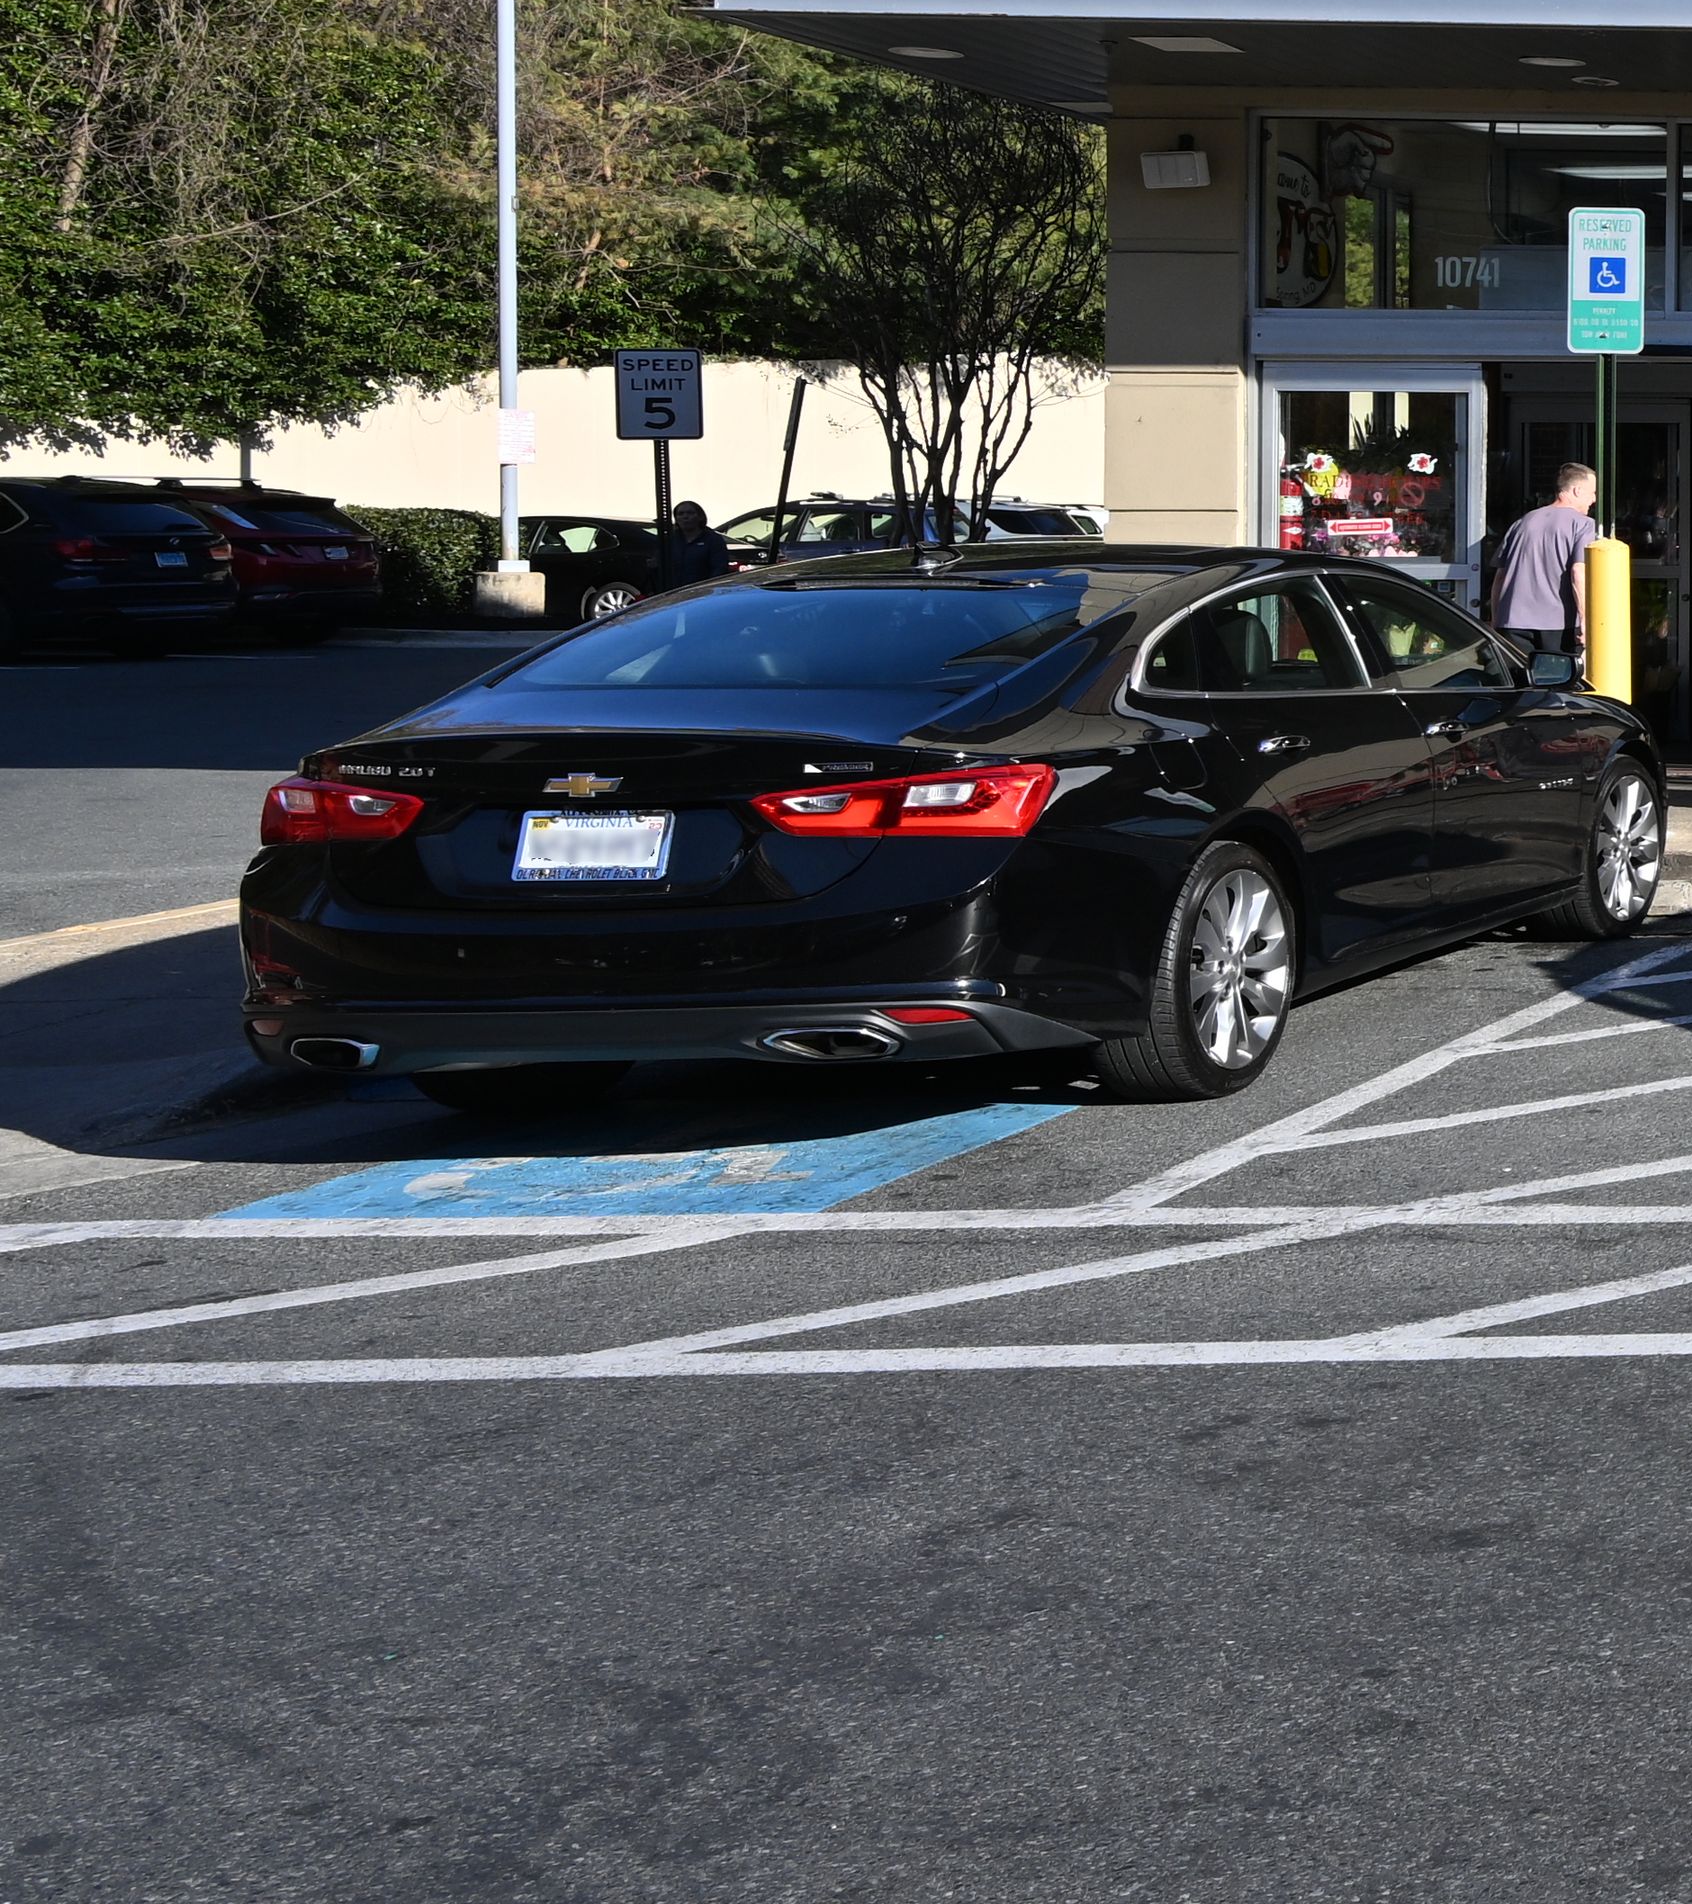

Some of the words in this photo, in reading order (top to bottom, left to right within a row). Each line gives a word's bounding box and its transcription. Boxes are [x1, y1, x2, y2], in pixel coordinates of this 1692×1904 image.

[1579, 218, 1632, 233] RESERVED
[1583, 237, 1627, 251] PARKING
[1434, 256, 1501, 288] 10741
[622, 358, 694, 372] SPEED
[630, 378, 687, 391] LIMIT
[644, 397, 676, 430] 5
[565, 817, 633, 829] VIRGINIA
